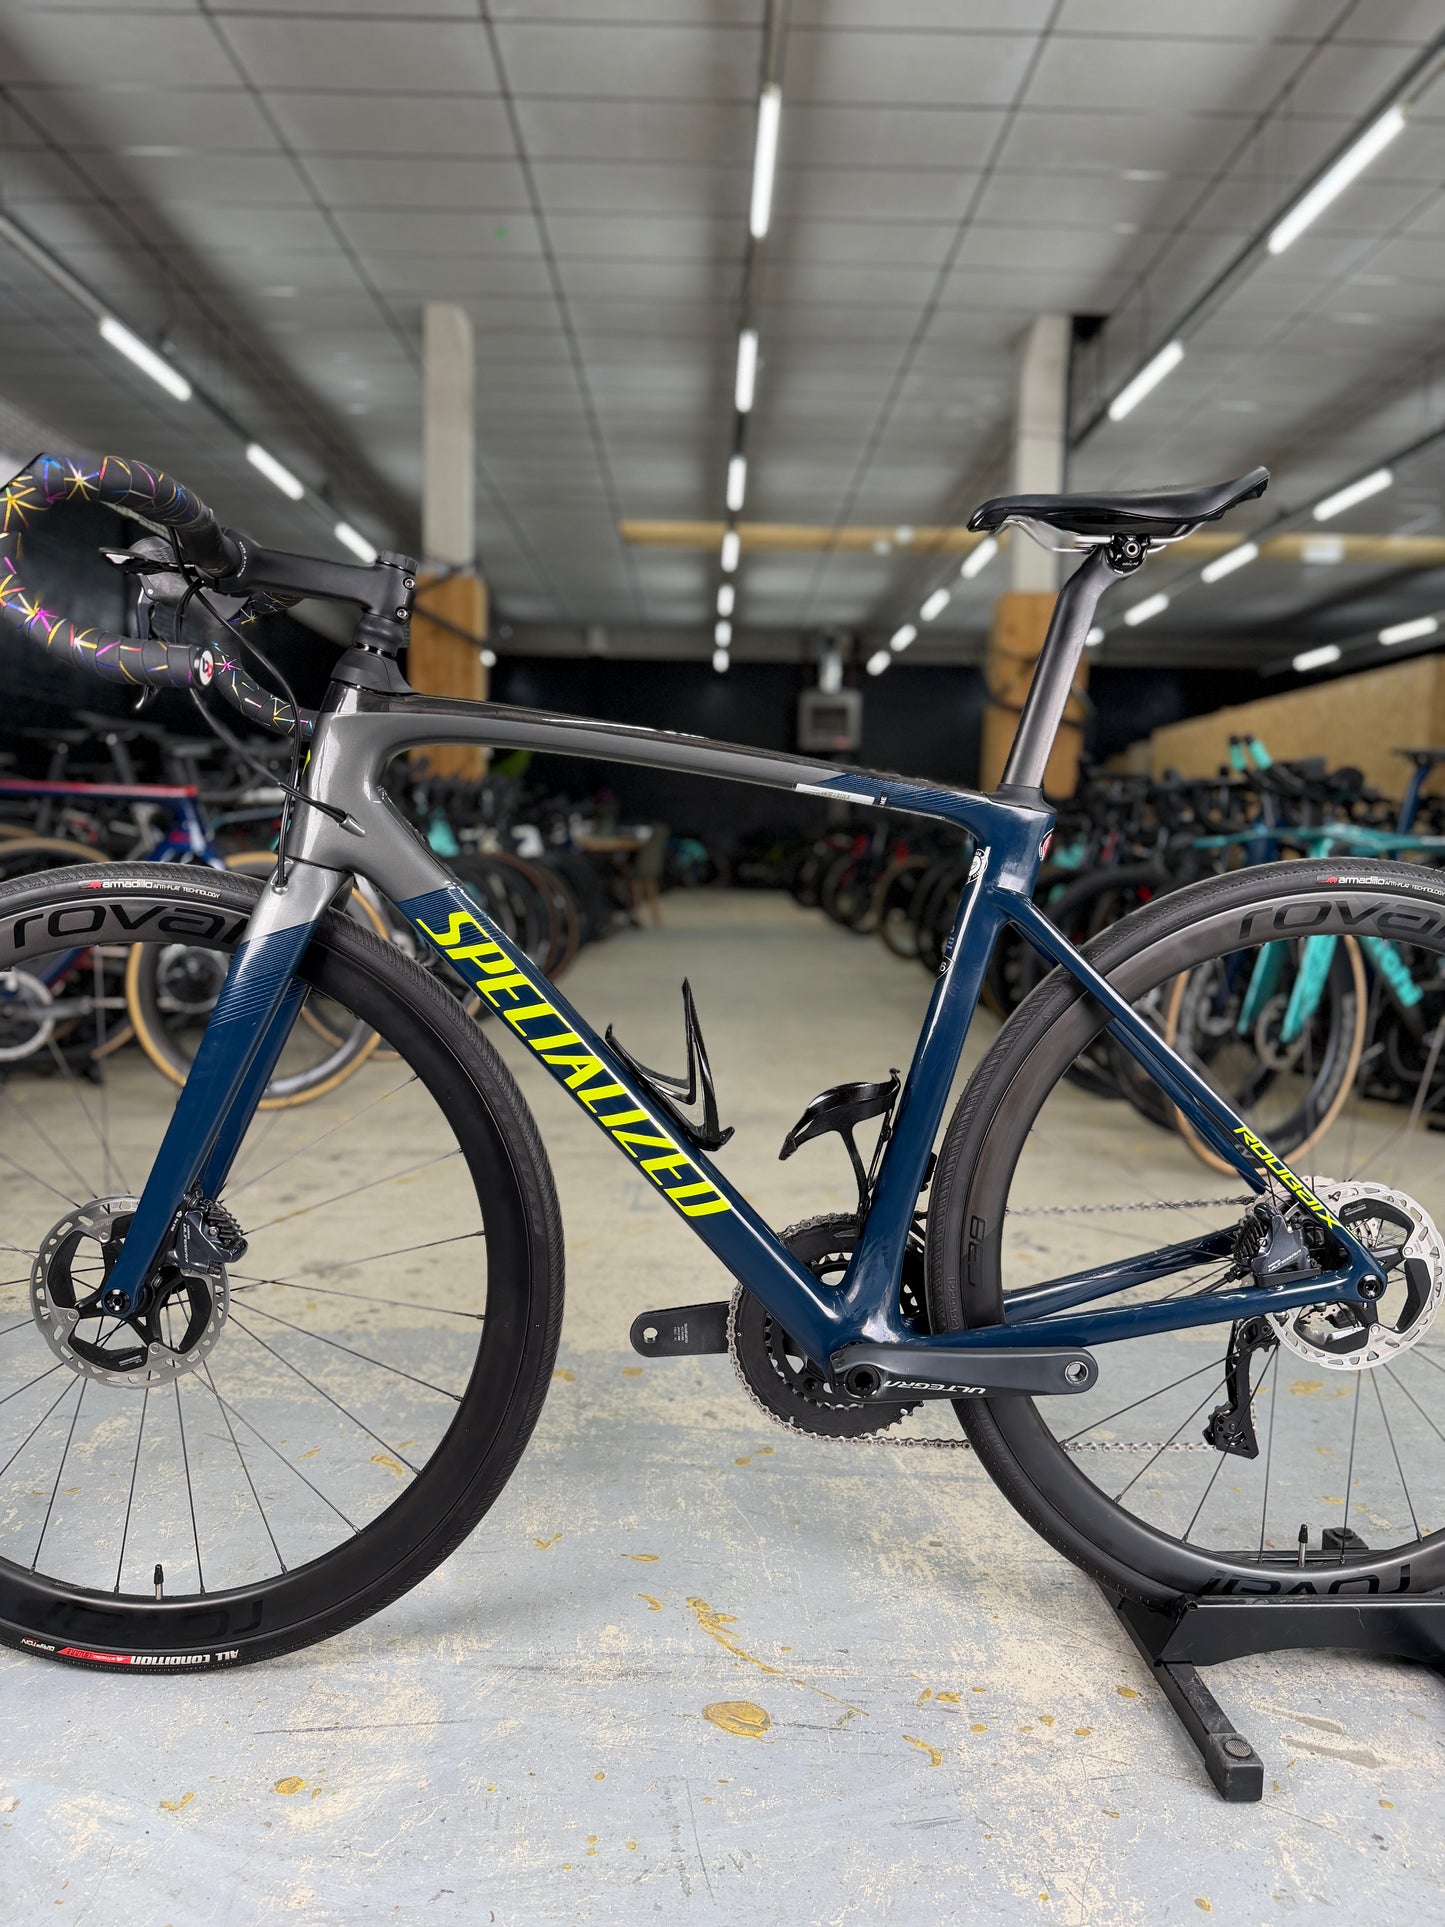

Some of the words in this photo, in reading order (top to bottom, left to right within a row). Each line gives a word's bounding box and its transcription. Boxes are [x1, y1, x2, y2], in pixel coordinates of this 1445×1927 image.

[1338, 876, 1385, 885] armadillo
[102, 879, 153, 889] armadillo
[153, 883, 181, 892] ANTI-FLAT
[182, 887, 221, 899] TECHNOLOGY
[416, 911, 732, 1217] SPECIALIZED
[882, 1380, 986, 1395] ULTEGRA
[20, 1637, 55, 1652] GRIPTON
[130, 1653, 210, 1666] CONDITION
[215, 1649, 240, 1662] ALL
